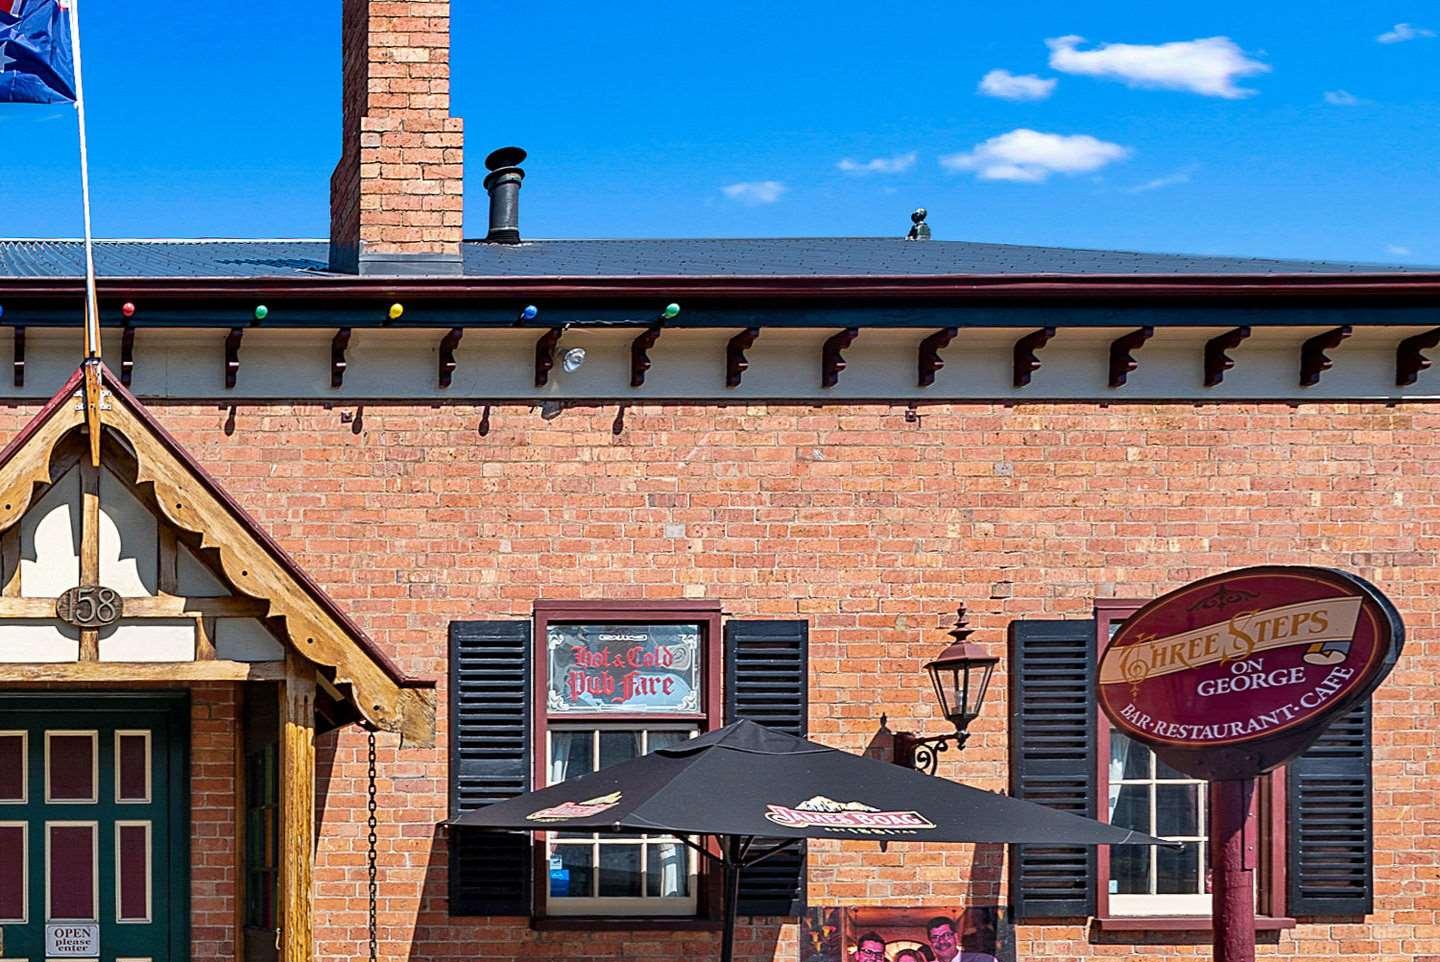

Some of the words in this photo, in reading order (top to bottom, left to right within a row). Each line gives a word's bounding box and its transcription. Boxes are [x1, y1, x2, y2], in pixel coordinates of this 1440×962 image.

[66, 588, 116, 622] 158
[570, 644, 610, 670] Hot
[612, 654, 625, 668] &
[626, 644, 674, 669] Cold
[1119, 632, 1220, 686] THREE
[1220, 608, 1329, 667] STEPS
[1231, 658, 1264, 675] ON
[566, 670, 615, 701] Pub
[611, 671, 674, 704] Fare
[1197, 667, 1306, 697] GEORGE
[1120, 703, 1151, 729] BAR
[1153, 703, 1294, 740] RESTAURANT
[1300, 665, 1354, 709] CAFE
[852, 812, 922, 825] BOAG
[54, 928, 91, 938] OPEN
[55, 938, 91, 947] please
